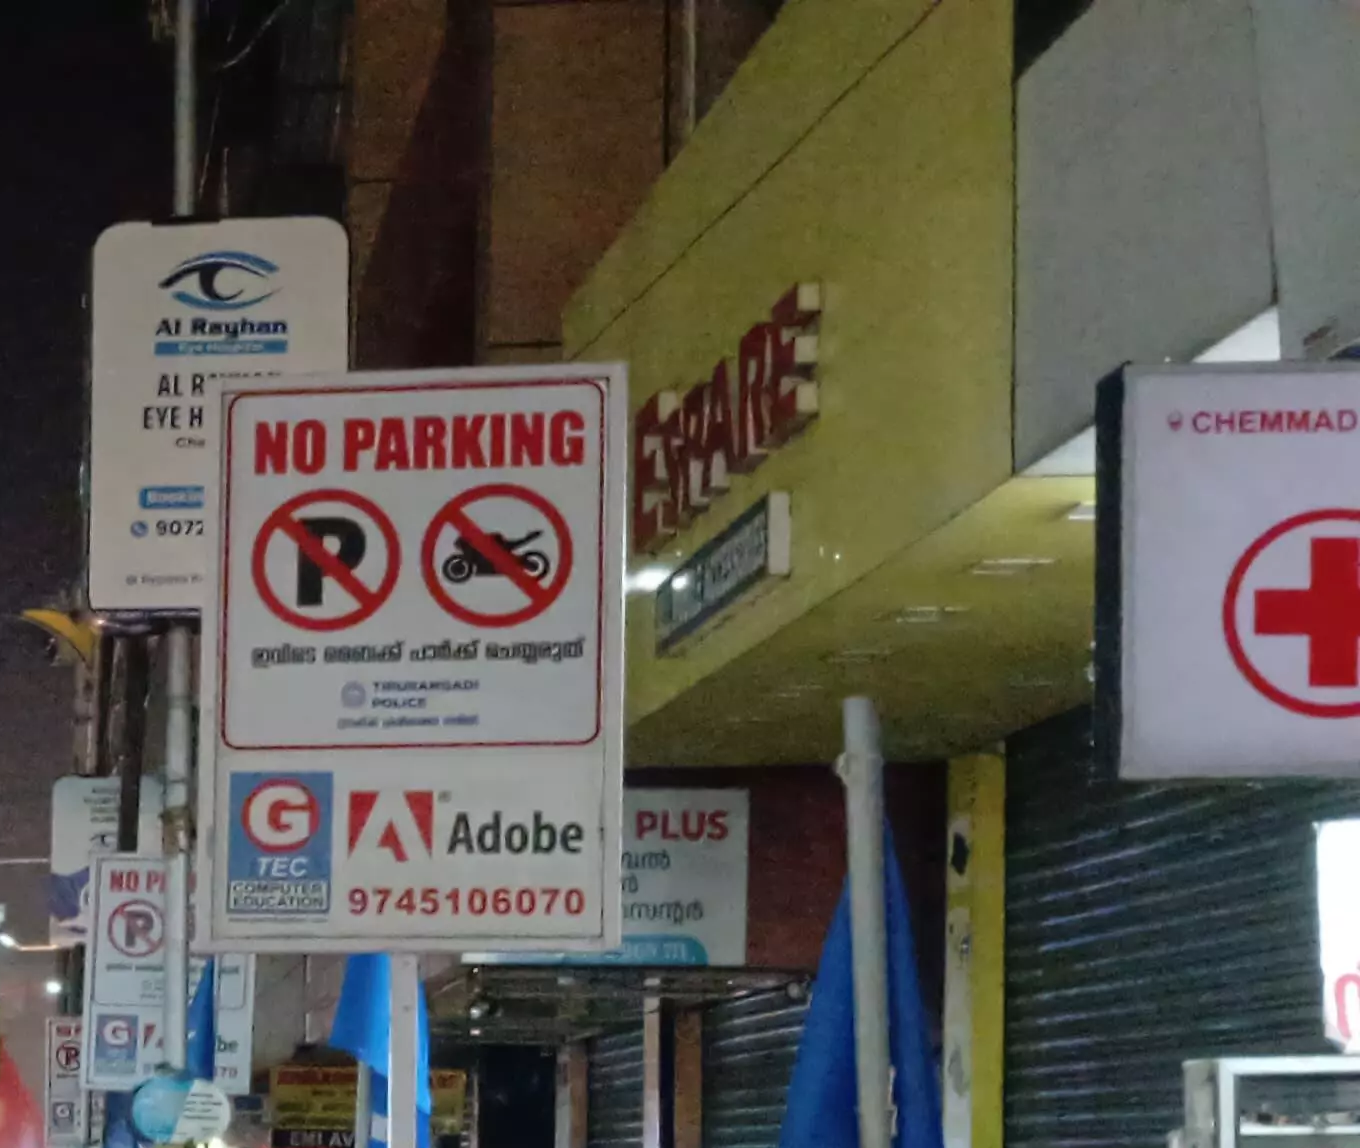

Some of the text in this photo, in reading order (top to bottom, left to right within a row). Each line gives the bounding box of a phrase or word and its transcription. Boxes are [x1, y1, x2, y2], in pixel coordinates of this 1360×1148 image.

[155, 317, 287, 340] Al Rayhan
[158, 373, 183, 396] AL
[143, 406, 181, 429] EYE
[1192, 409, 1358, 434] CHEMMAD
[254, 409, 586, 476] NO PARKING
[371, 697, 427, 708] POLICE
[248, 783, 311, 848] G
[636, 810, 729, 841] PLUS
[447, 811, 585, 855] Adobe
[258, 857, 310, 877] TEC
[109, 870, 140, 893] NO
[233, 881, 323, 895] COMPUTER
[233, 895, 323, 908] EDUCATION
[348, 887, 586, 916] 9745106070
